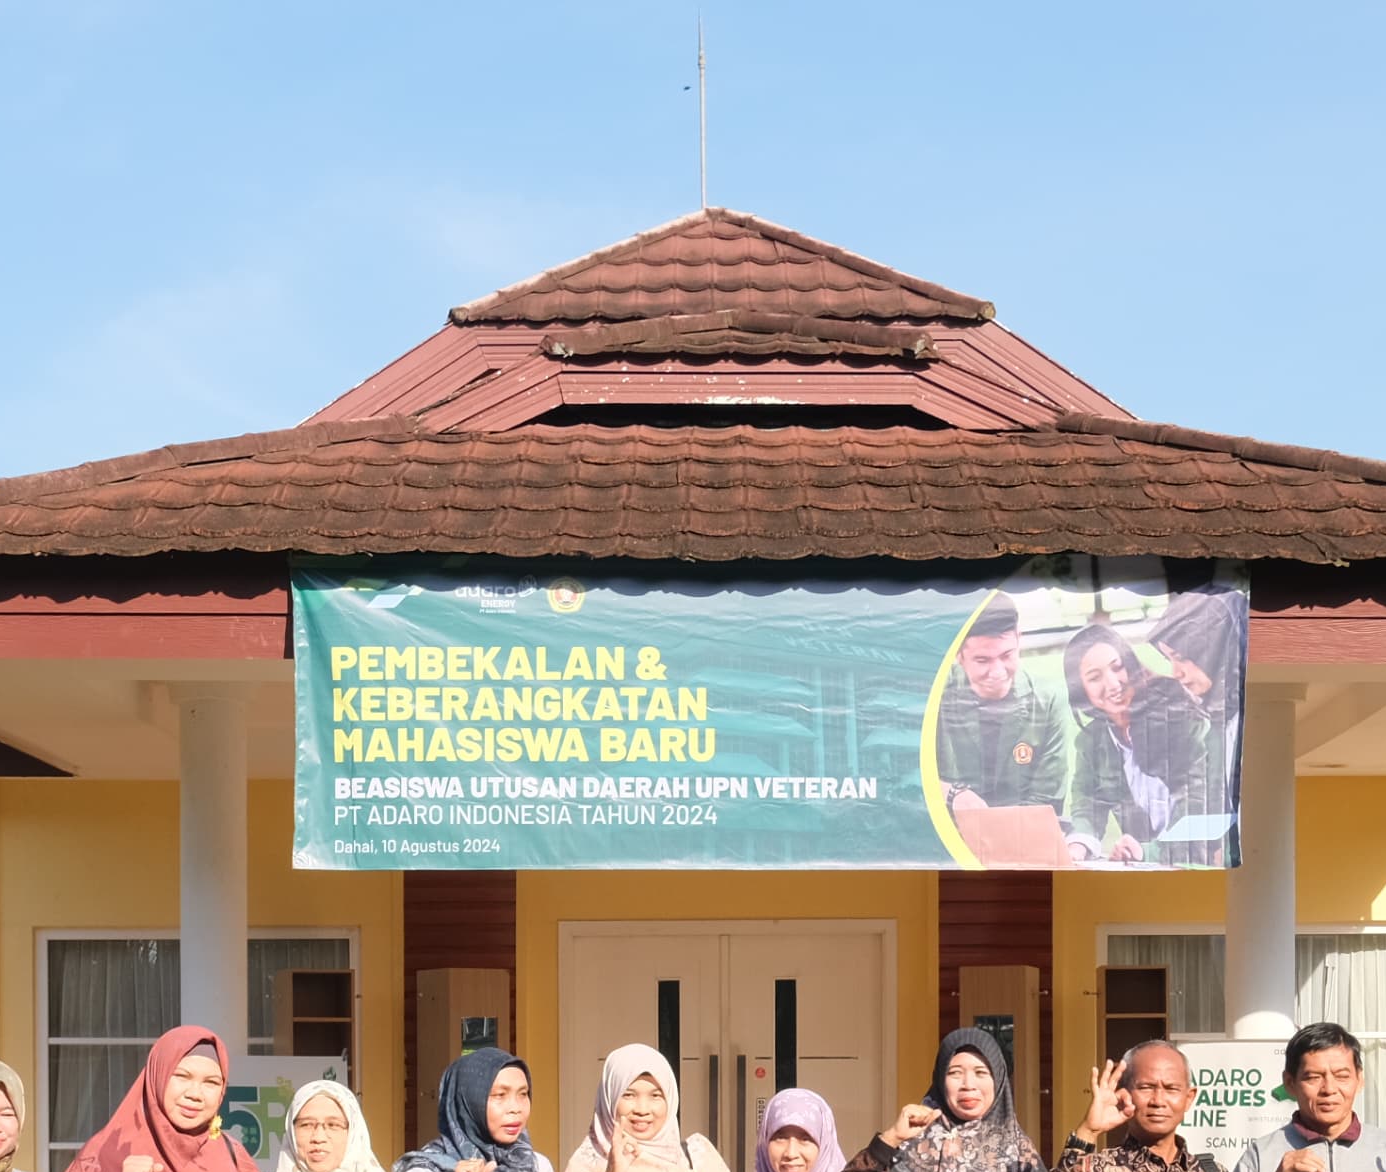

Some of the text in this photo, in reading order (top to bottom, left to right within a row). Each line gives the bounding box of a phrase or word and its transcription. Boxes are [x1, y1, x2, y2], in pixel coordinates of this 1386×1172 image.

[331, 646, 667, 681] PEMBEKALAN &
[332, 687, 707, 722] KEBERANGKATAN
[333, 727, 716, 763] MAHASISWA BARU
[334, 776, 877, 799] BEASISWA UTUSAN DAERAH UPN VETERAN
[334, 804, 718, 825] PT ADARO INDONESIA TAHUN 2024
[334, 838, 500, 856] Dahai, 10 Agustus 2024
[1196, 1089, 1266, 1107] ALUES
[1205, 1137, 1237, 1148] SCAN
